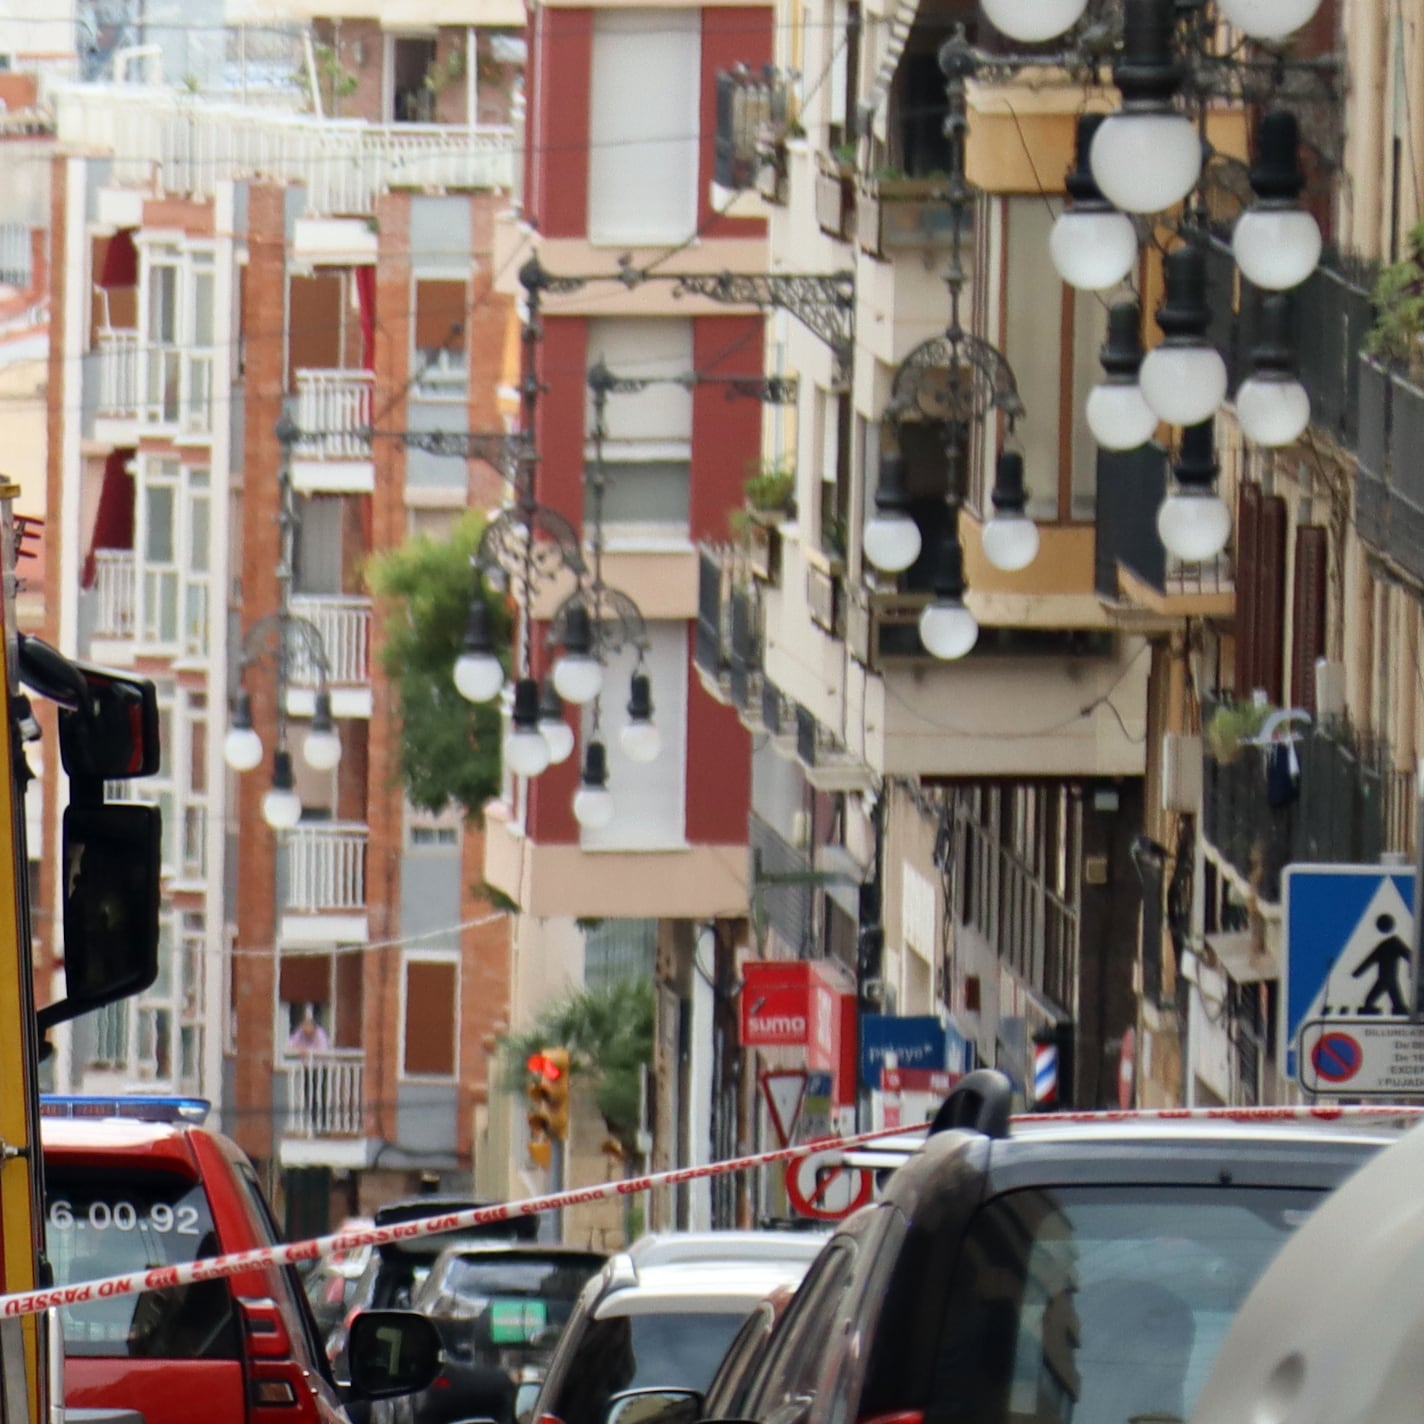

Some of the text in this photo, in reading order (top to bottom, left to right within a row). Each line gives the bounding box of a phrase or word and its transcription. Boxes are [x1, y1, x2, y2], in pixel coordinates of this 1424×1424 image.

[49, 1200, 201, 1237] 6.00.92
[4, 1277, 134, 1317] NO PASSEU
